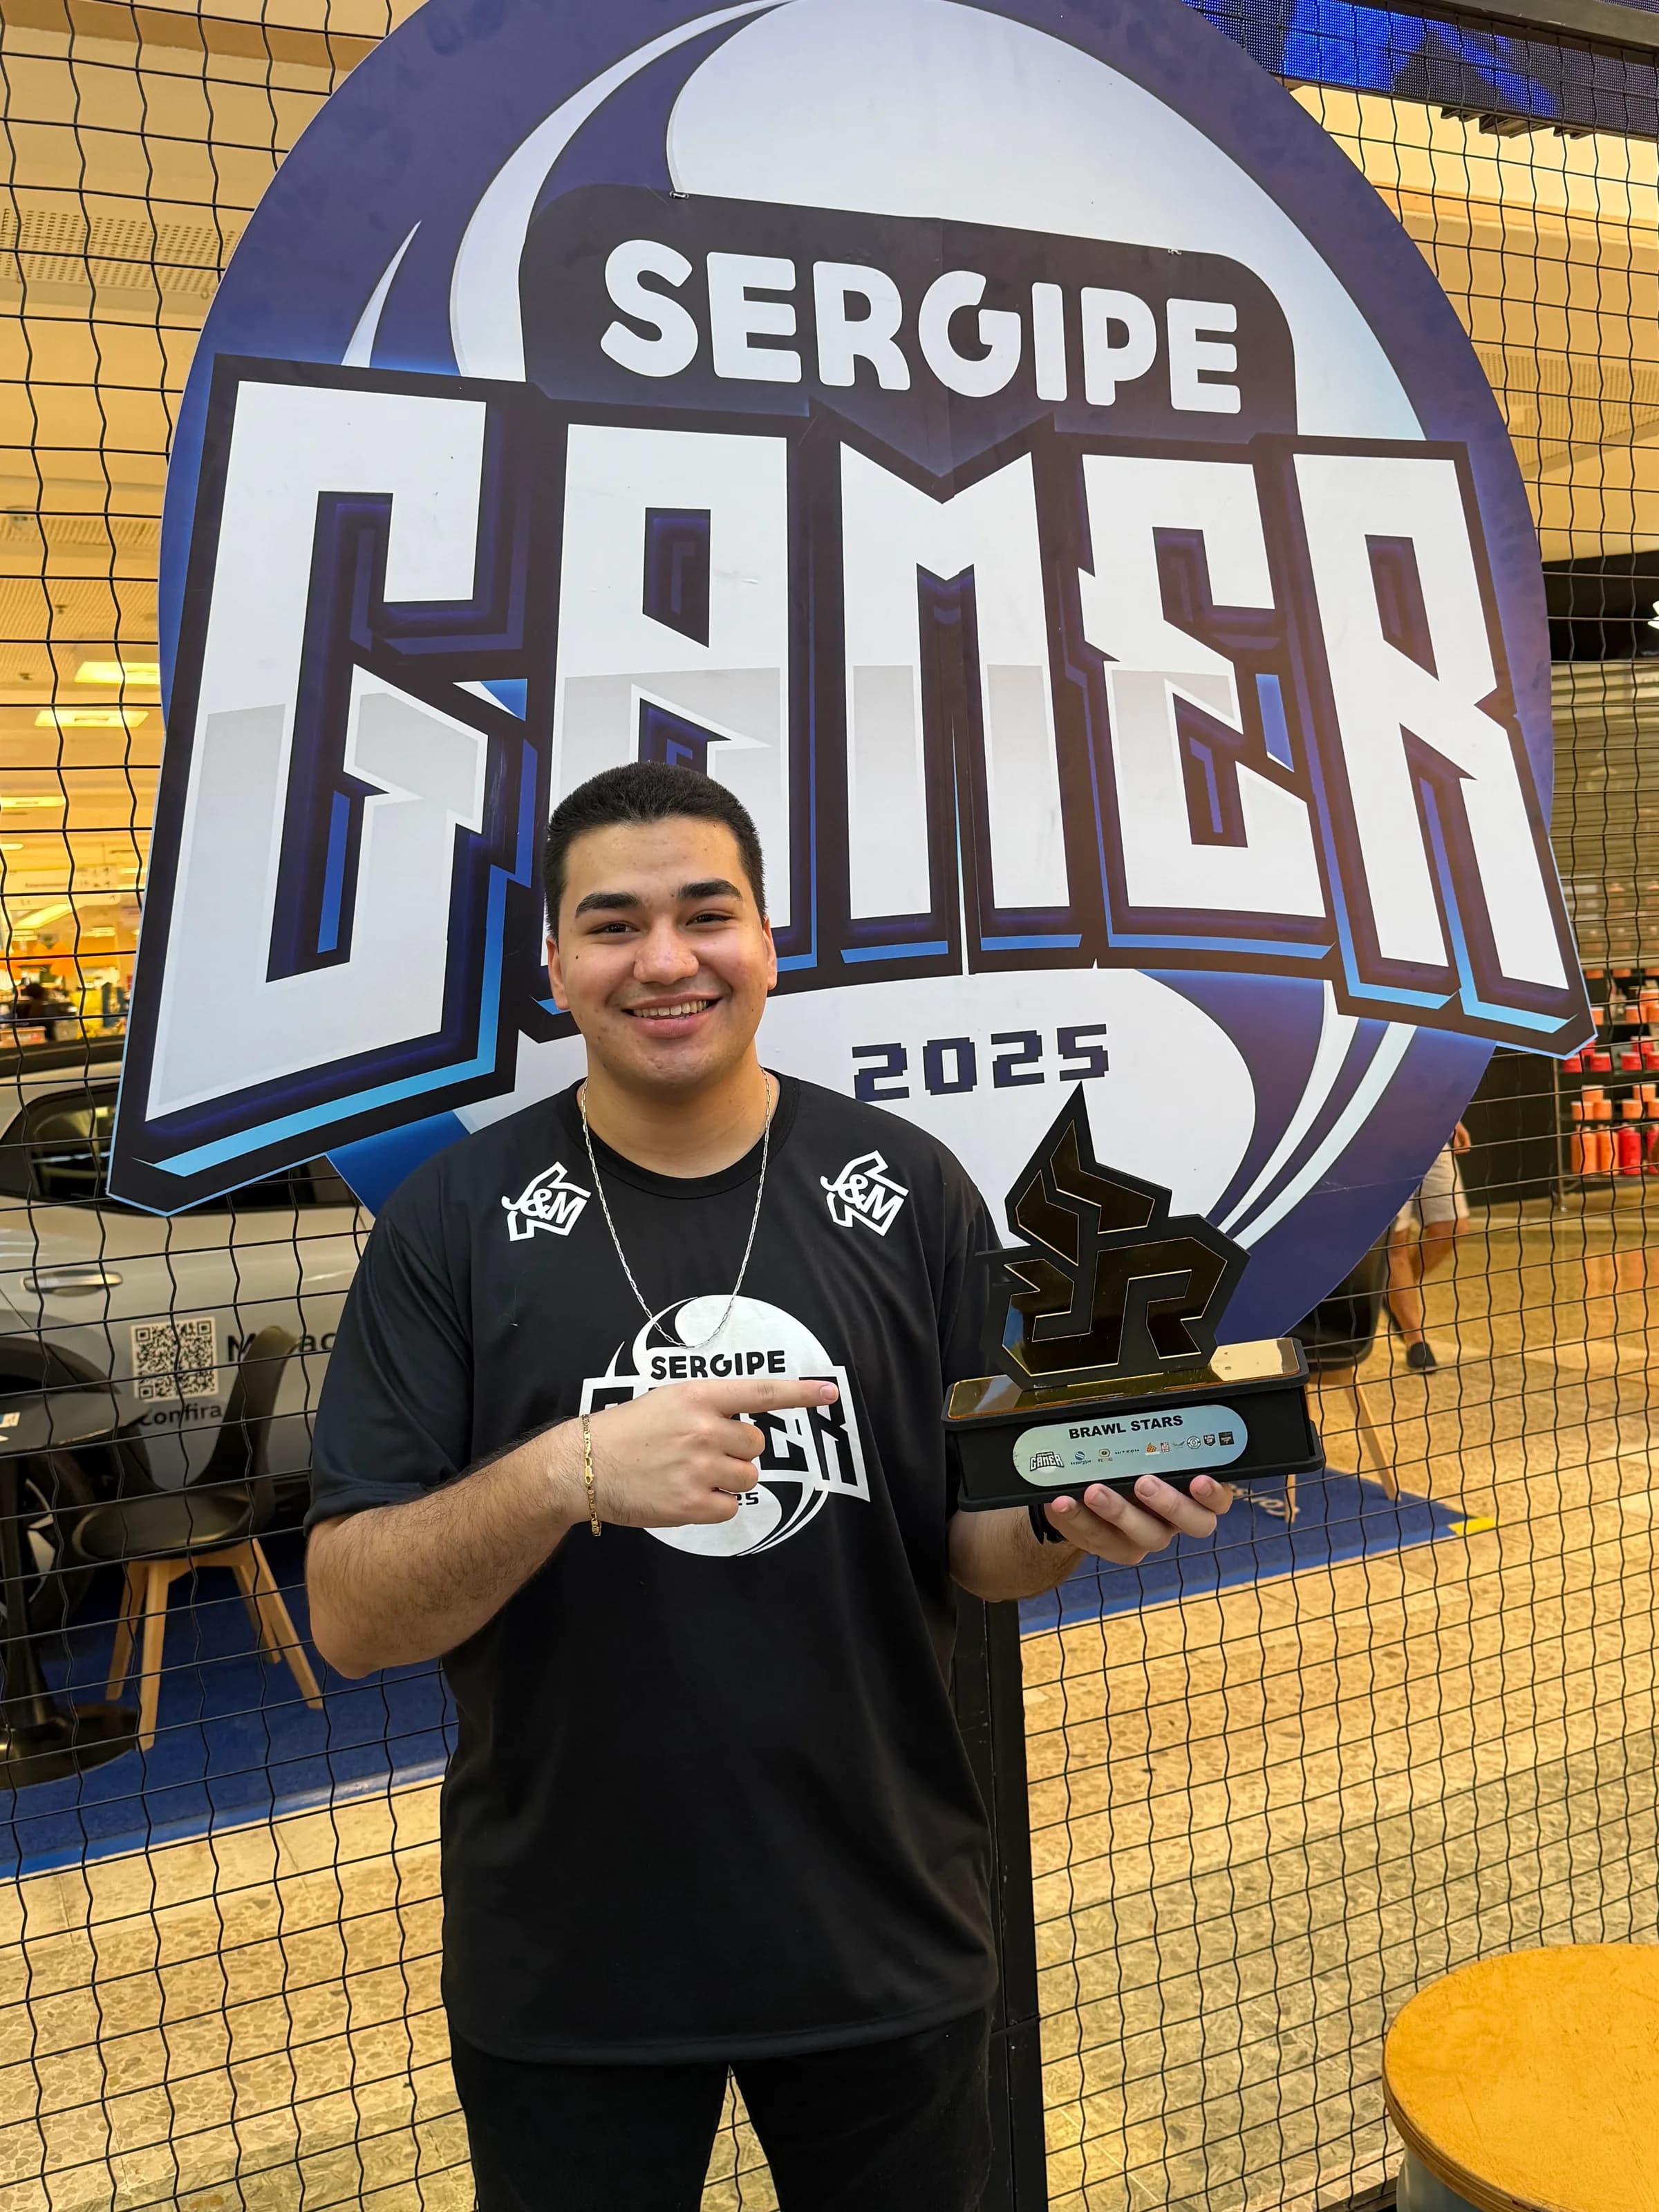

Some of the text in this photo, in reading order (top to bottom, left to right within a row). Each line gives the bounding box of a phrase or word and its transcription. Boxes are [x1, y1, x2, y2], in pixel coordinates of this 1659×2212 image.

[600, 239, 1241, 414] SERGIPE
[145, 378, 1570, 1123] GAMER
[852, 1023, 1109, 1103] 2025
[650, 1349, 787, 1380] SERGIPE
[1068, 1415, 1183, 1440] BRAWL STARS
[1030, 1454, 1064, 1471] GAMER
